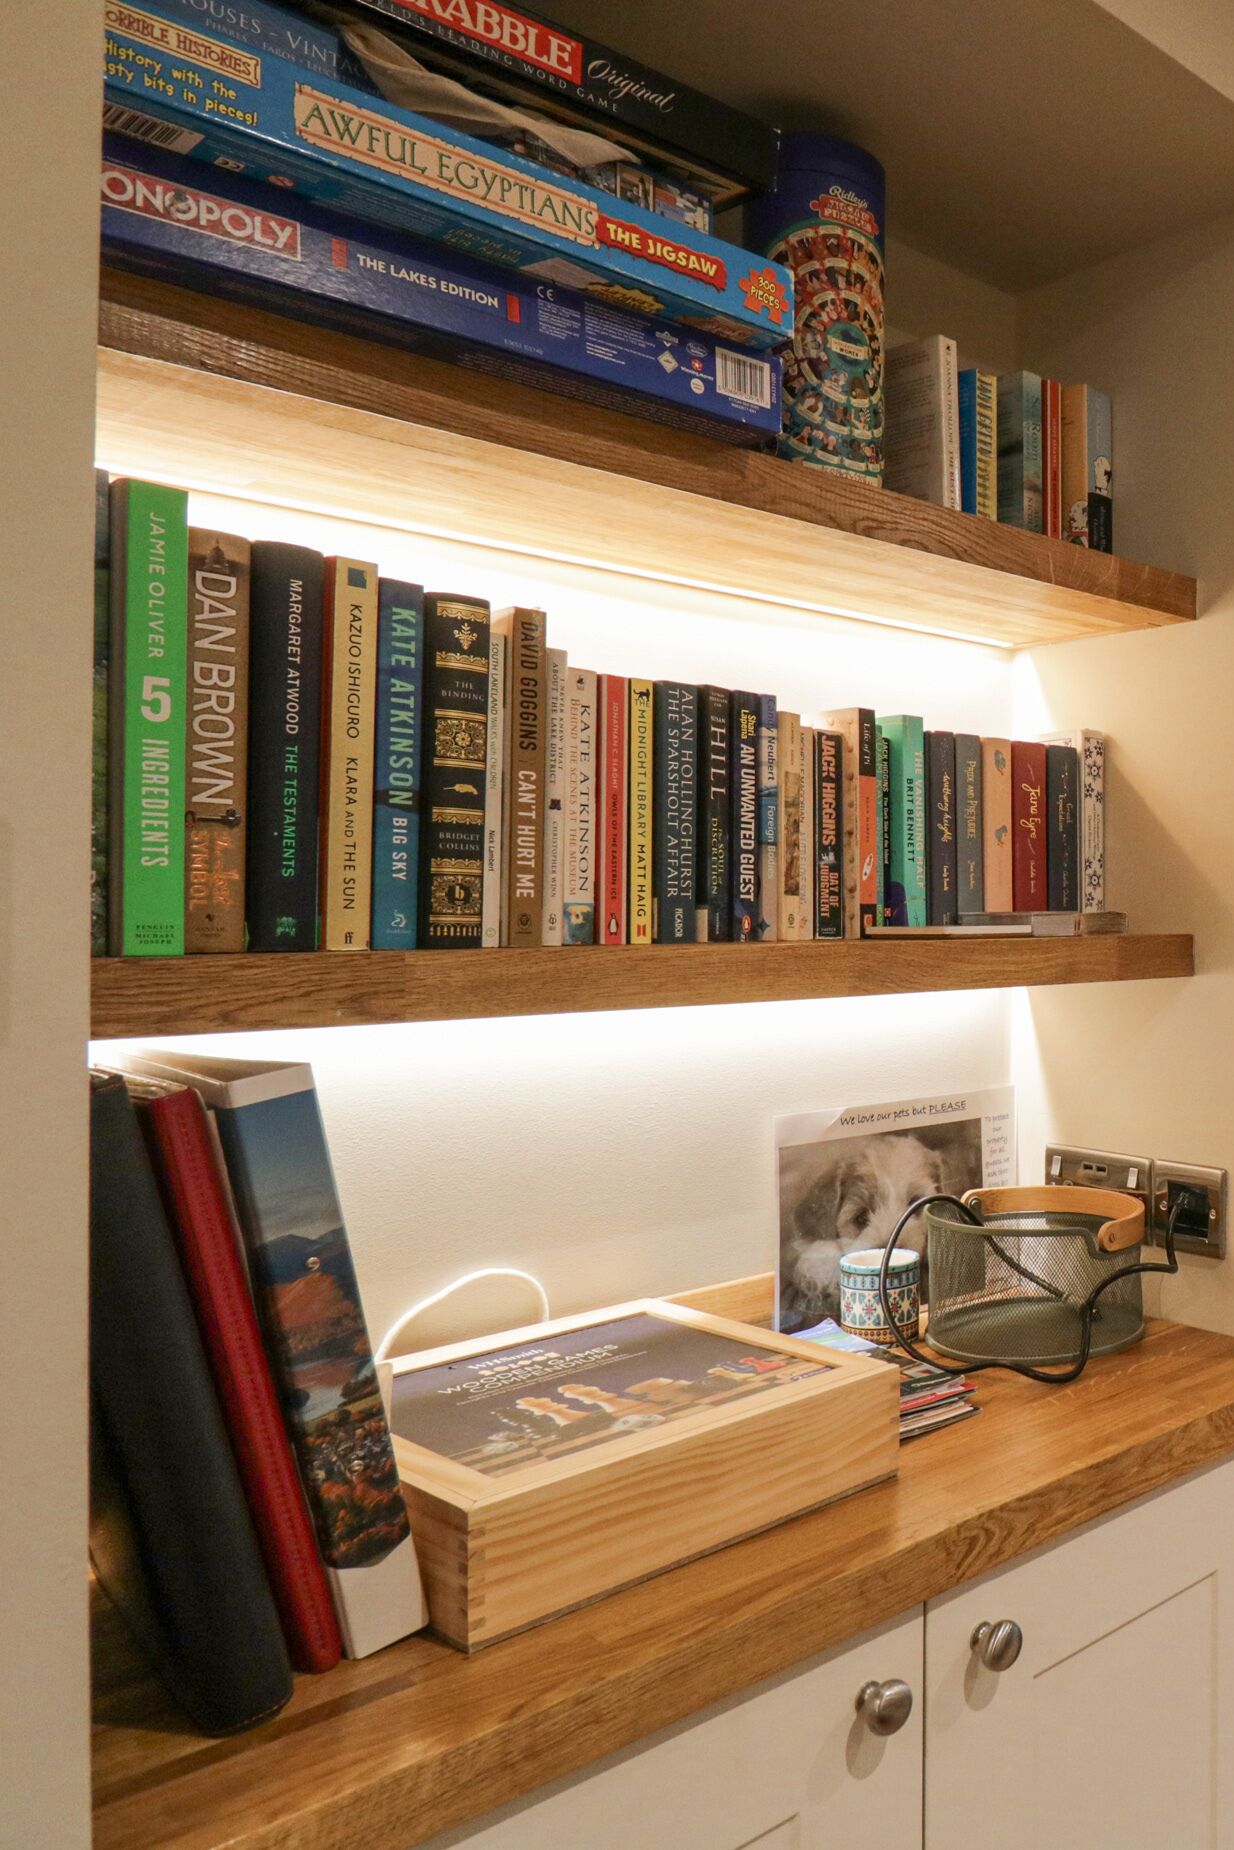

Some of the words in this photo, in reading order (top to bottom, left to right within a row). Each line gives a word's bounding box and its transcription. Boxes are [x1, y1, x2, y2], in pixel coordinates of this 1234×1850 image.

[106, 10, 170, 45] ORRIBLE
[176, 32, 252, 77] HISTORIES
[105, 38, 162, 75] History
[171, 68, 204, 89] with
[212, 79, 238, 101] the
[437, 25, 513, 66] LEADING
[523, 63, 567, 89] WORD
[576, 88, 619, 112] GAME
[587, 59, 676, 114] Original
[143, 73, 175, 97] bits
[183, 88, 197, 105] in
[204, 97, 259, 126] pieces!
[302, 103, 428, 175] AWFUL
[436, 150, 596, 237] EGYPTIANS
[101, 170, 294, 249] ONOPOLY
[829, 185, 870, 210] Ridley's
[606, 222, 643, 250] THE
[647, 239, 719, 279] JIGSAW
[356, 253, 387, 275] THE
[390, 264, 438, 290] LAKES
[440, 280, 500, 310] EDITION
[750, 285, 781, 311] PIECES
[757, 276, 777, 294] 300
[149, 512, 166, 576] JAMIE
[148, 581, 166, 659] OLIVER
[193, 569, 238, 653] DAN
[287, 578, 303, 665] MARGARET
[348, 602, 363, 658] KAZUO
[391, 606, 417, 669] KATE
[490, 641, 499, 671] SOUTH
[519, 620, 539, 671] DAVID
[441, 689, 485, 702] BINDING
[455, 680, 474, 691] THE
[489, 672, 499, 716] LAKELAND
[551, 662, 559, 694] ABOUT
[140, 675, 172, 723] 5
[285, 667, 301, 735] ATWOOD
[346, 661, 361, 739] ISHIGURO
[518, 676, 539, 752] GOGGINS
[550, 696, 559, 714] THE
[667, 688, 680, 721] THE
[680, 689, 694, 740] ALAN
[191, 660, 237, 805] BROWN
[550, 717, 558, 739] LAKE
[569, 698, 580, 740] BEHIND
[579, 703, 592, 763] KATE
[611, 702, 620, 746] JONATHAN
[740, 709, 750, 740] Lapena
[747, 713, 758, 736] Shari
[863, 722, 871, 742] Life
[284, 745, 298, 774] THE
[388, 677, 416, 806] ATKINSON
[569, 744, 579, 764] THE
[637, 708, 648, 778] MIDNIGHT
[740, 743, 756, 766] AN
[767, 736, 776, 781] Neubert
[821, 734, 837, 779] JACK
[863, 744, 870, 754] of
[863, 754, 870, 765] Pi
[345, 757, 359, 806] KLARA
[549, 743, 558, 784] DISTRICT
[667, 728, 680, 829] SPARSHOLT
[710, 725, 727, 800] HILL
[914, 751, 925, 775] THE
[966, 760, 978, 783] PRIDE
[140, 738, 170, 867] INGREDIENTS
[517, 770, 537, 819] CAN'T
[568, 767, 578, 806] SCENES
[610, 793, 619, 817] OWLS
[906, 778, 914, 804] BRIT
[967, 785, 975, 798] AND
[1021, 783, 1042, 815] Jane
[281, 778, 297, 878] TESTAMENTS
[344, 810, 355, 838] AND
[568, 810, 577, 821] AT
[610, 820, 619, 830] OF
[636, 781, 647, 838] LIBRARY
[680, 750, 693, 900] HOLLINGHURST
[740, 769, 756, 850] UNWANTED
[765, 805, 777, 843] Foreign
[822, 782, 837, 846] HIGGINS
[915, 779, 926, 852] VANISHING
[964, 800, 978, 839] PREJUDICE
[1019, 817, 1042, 840] Eyre
[392, 817, 408, 844] BIG
[438, 831, 481, 842] BRIDGET
[438, 842, 480, 852] COLLINS
[516, 824, 536, 868] HURT
[551, 820, 559, 875] CHRISTOPHER
[568, 827, 577, 846] THE
[578, 771, 591, 892] ATKINSON
[610, 833, 619, 847] THE
[906, 809, 915, 863] BENNETT
[188, 830, 210, 912] SYMBOL
[344, 842, 357, 871] THE
[392, 851, 408, 880] SKY
[487, 846, 496, 872] Lambert
[568, 850, 577, 896] MUSEUM
[610, 849, 619, 885] EASTERN
[636, 844, 647, 879] MATT
[666, 835, 679, 898] AFFAIR
[717, 843, 725, 873] SOUL
[767, 845, 777, 880] Bodies
[916, 856, 926, 889] HALF
[342, 877, 356, 910] SUN
[515, 873, 535, 898] ME
[550, 877, 558, 898] WINN
[610, 887, 618, 900] ICE
[740, 854, 755, 902] GUEST
[820, 863, 830, 917] JUDGMENT
[829, 872, 839, 892] DAY
[636, 884, 647, 917] HAIG
[829, 896, 839, 908] OF
[674, 907, 684, 938] PICADOR
[840, 1116, 855, 1126] We
[857, 1113, 875, 1124] love
[876, 1112, 891, 1121] our
[893, 1109, 910, 1122] pets
[912, 1105, 926, 1115] but
[928, 1100, 967, 1114] PLEASE
[437, 1364, 544, 1395] WOODEN
[548, 1344, 619, 1367] GAMES
[468, 1348, 544, 1370] WHSmith
[469, 1351, 614, 1394] COMPENDIUM
